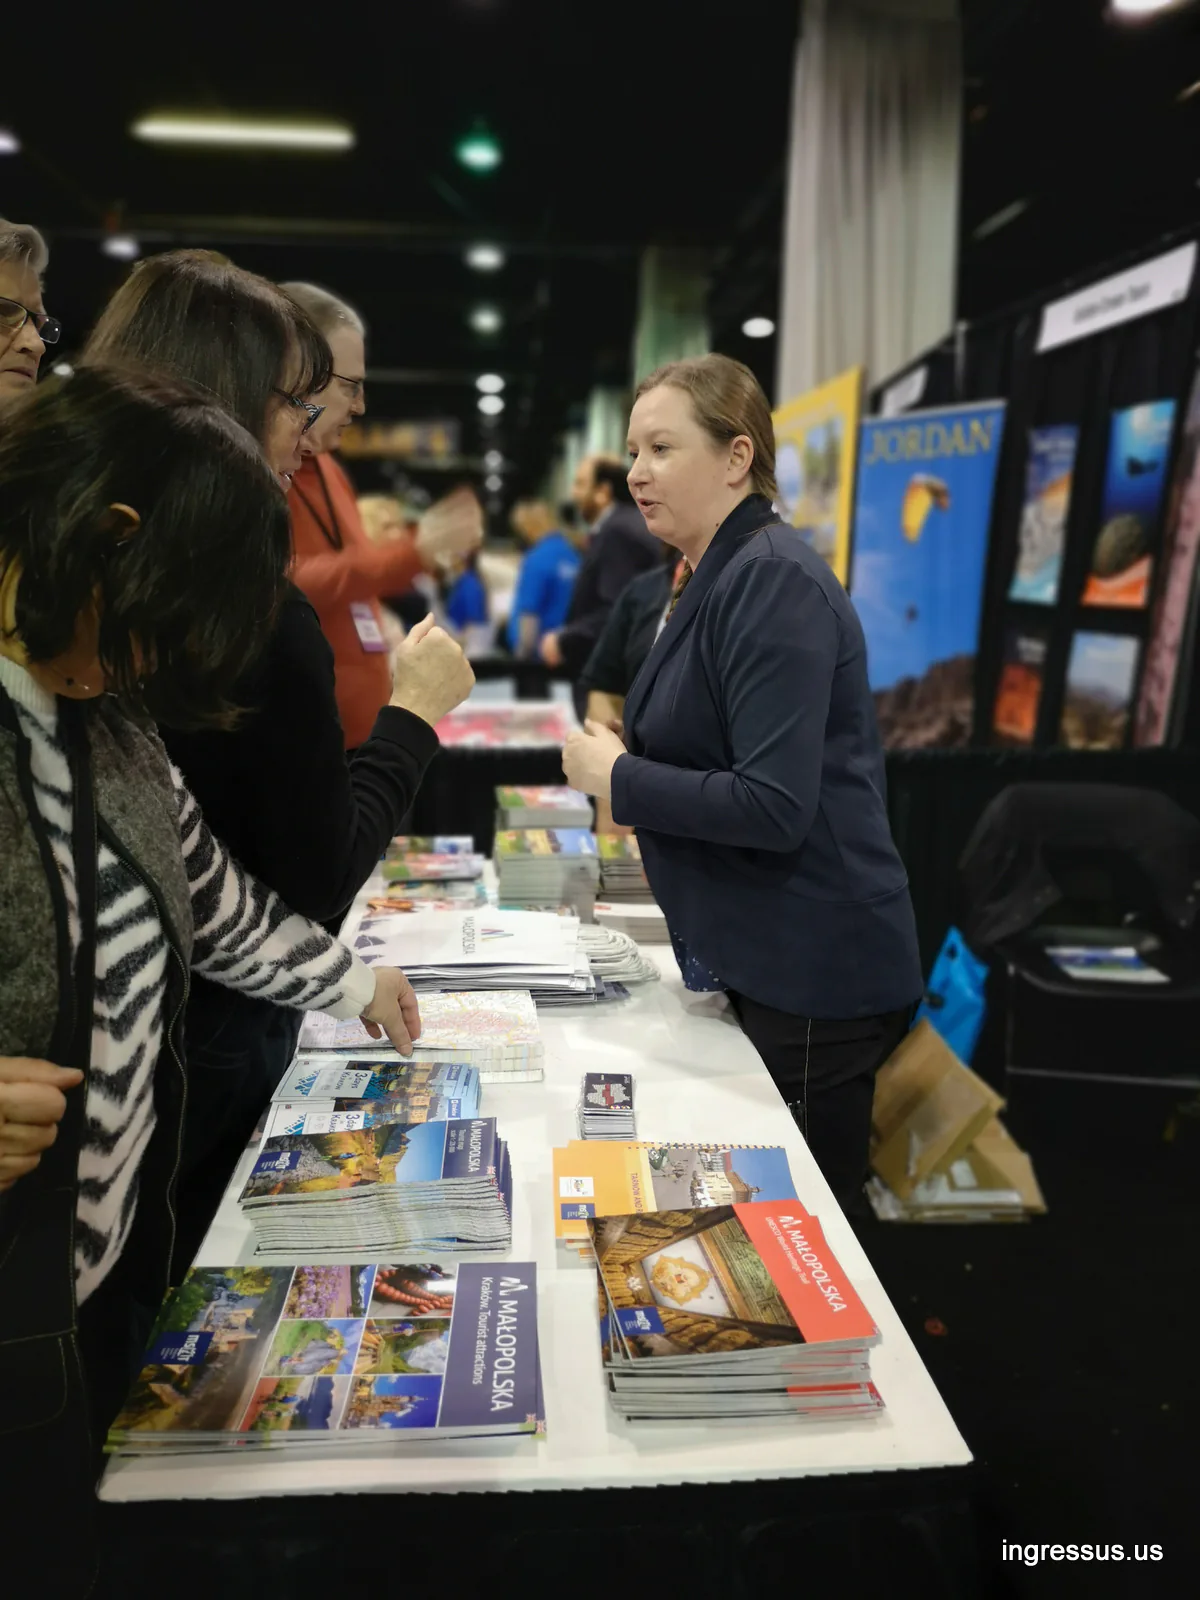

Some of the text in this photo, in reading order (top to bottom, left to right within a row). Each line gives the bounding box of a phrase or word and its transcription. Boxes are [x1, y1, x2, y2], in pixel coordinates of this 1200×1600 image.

[866, 417, 993, 465] JORDAN
[468, 1128, 482, 1172] MAŁOPOLSKA
[786, 1230, 848, 1312] MAŁOPOLSKA
[472, 1277, 494, 1385] Kraków. Tourist attractions
[490, 1300, 518, 1411] MAŁOPOLSKA
